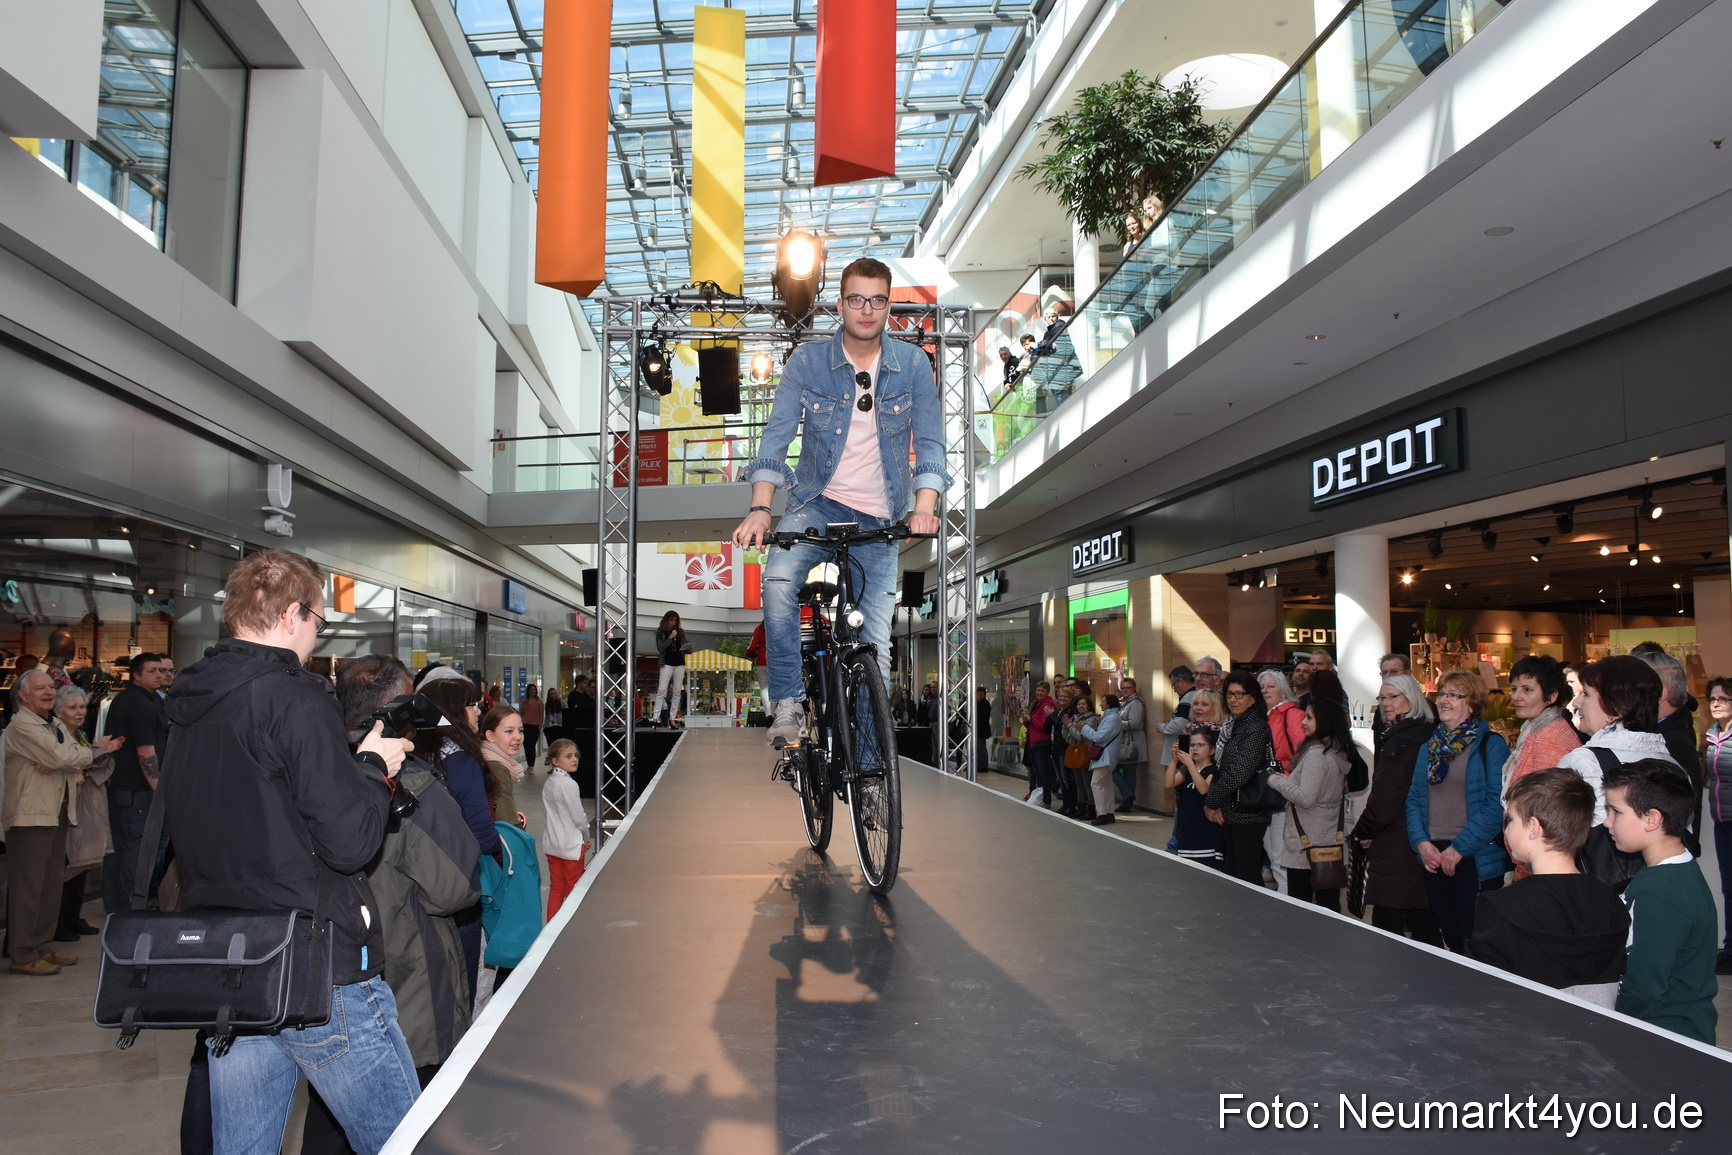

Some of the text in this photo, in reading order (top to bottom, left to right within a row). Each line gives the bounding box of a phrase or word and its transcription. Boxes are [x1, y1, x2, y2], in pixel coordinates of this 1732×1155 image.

[1312, 416, 1443, 498] DEPOT
[1073, 530, 1122, 570] DEPOT
[1285, 628, 1336, 643] EPOT
